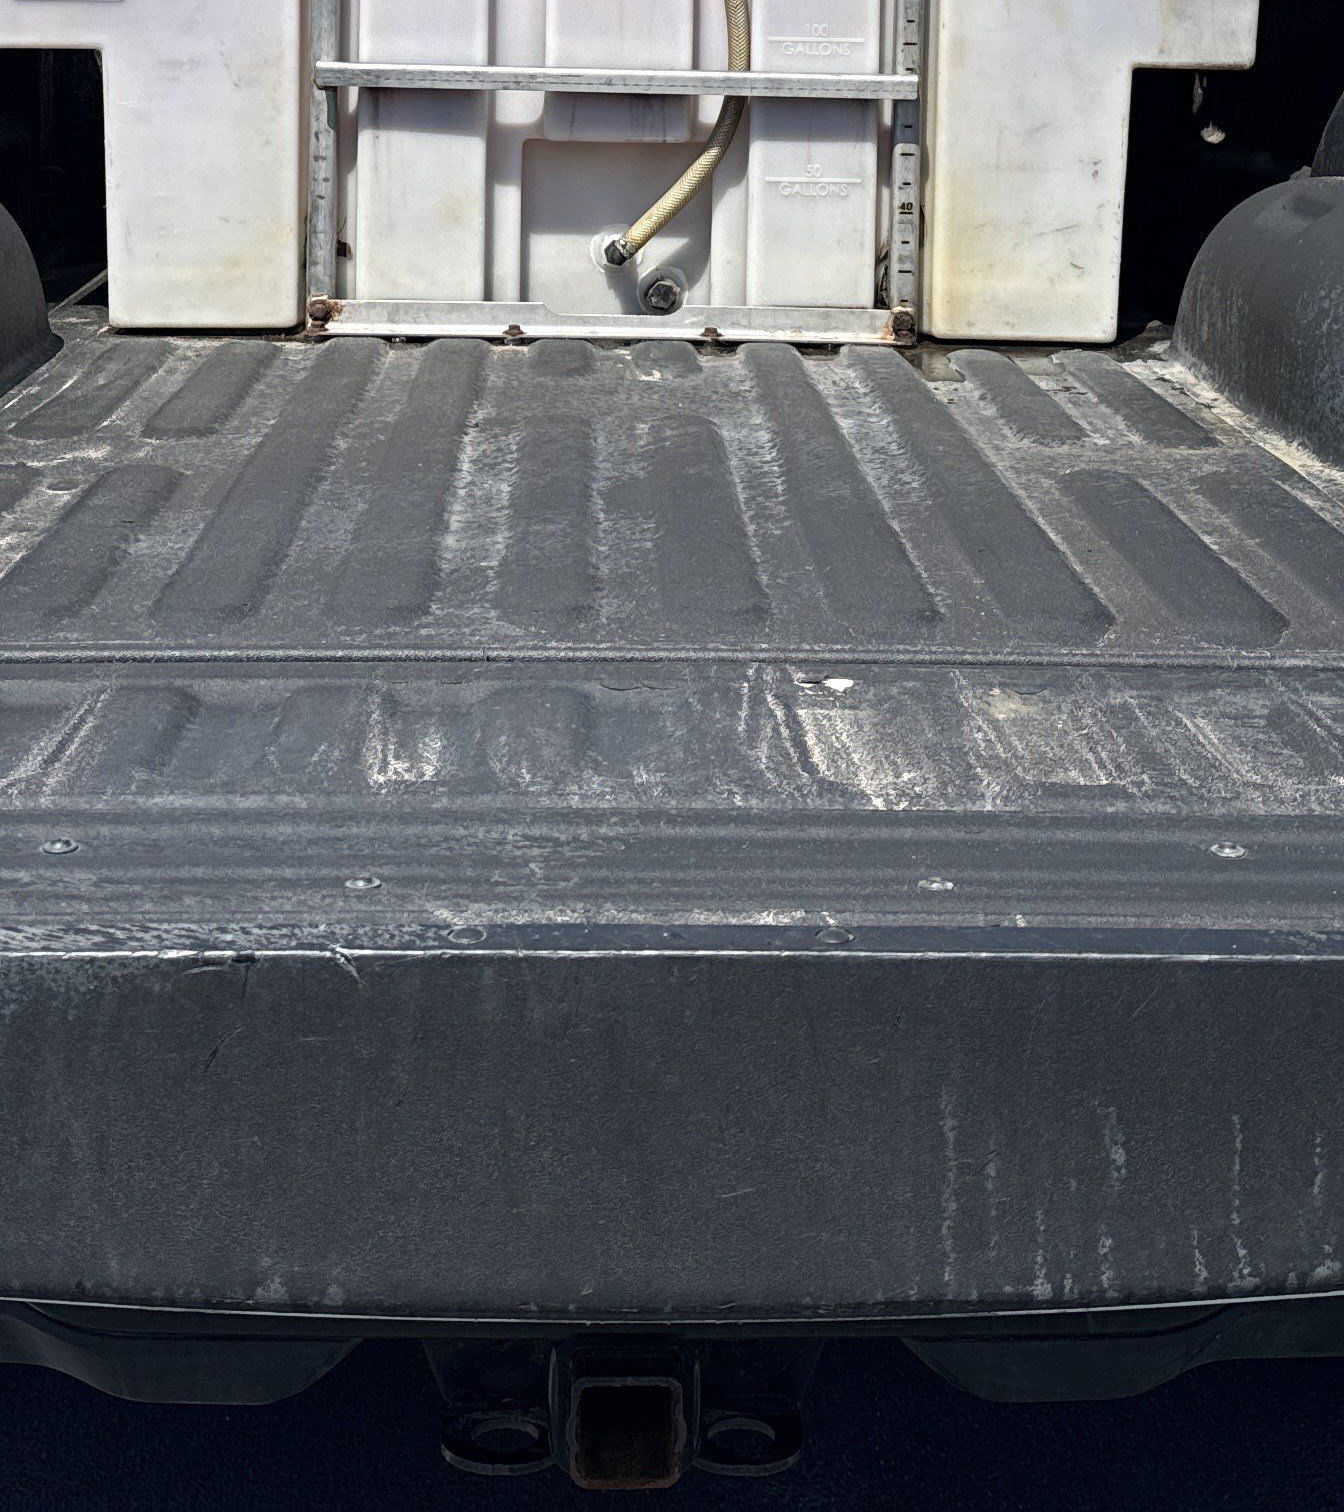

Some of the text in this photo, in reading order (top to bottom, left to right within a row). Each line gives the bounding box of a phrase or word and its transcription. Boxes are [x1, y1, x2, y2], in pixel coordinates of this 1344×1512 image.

[806, 23, 829, 37] 100
[782, 41, 851, 56] GALLONS
[804, 163, 823, 178] 50
[779, 182, 848, 197] GALLONS
[898, 201, 914, 211] 40
